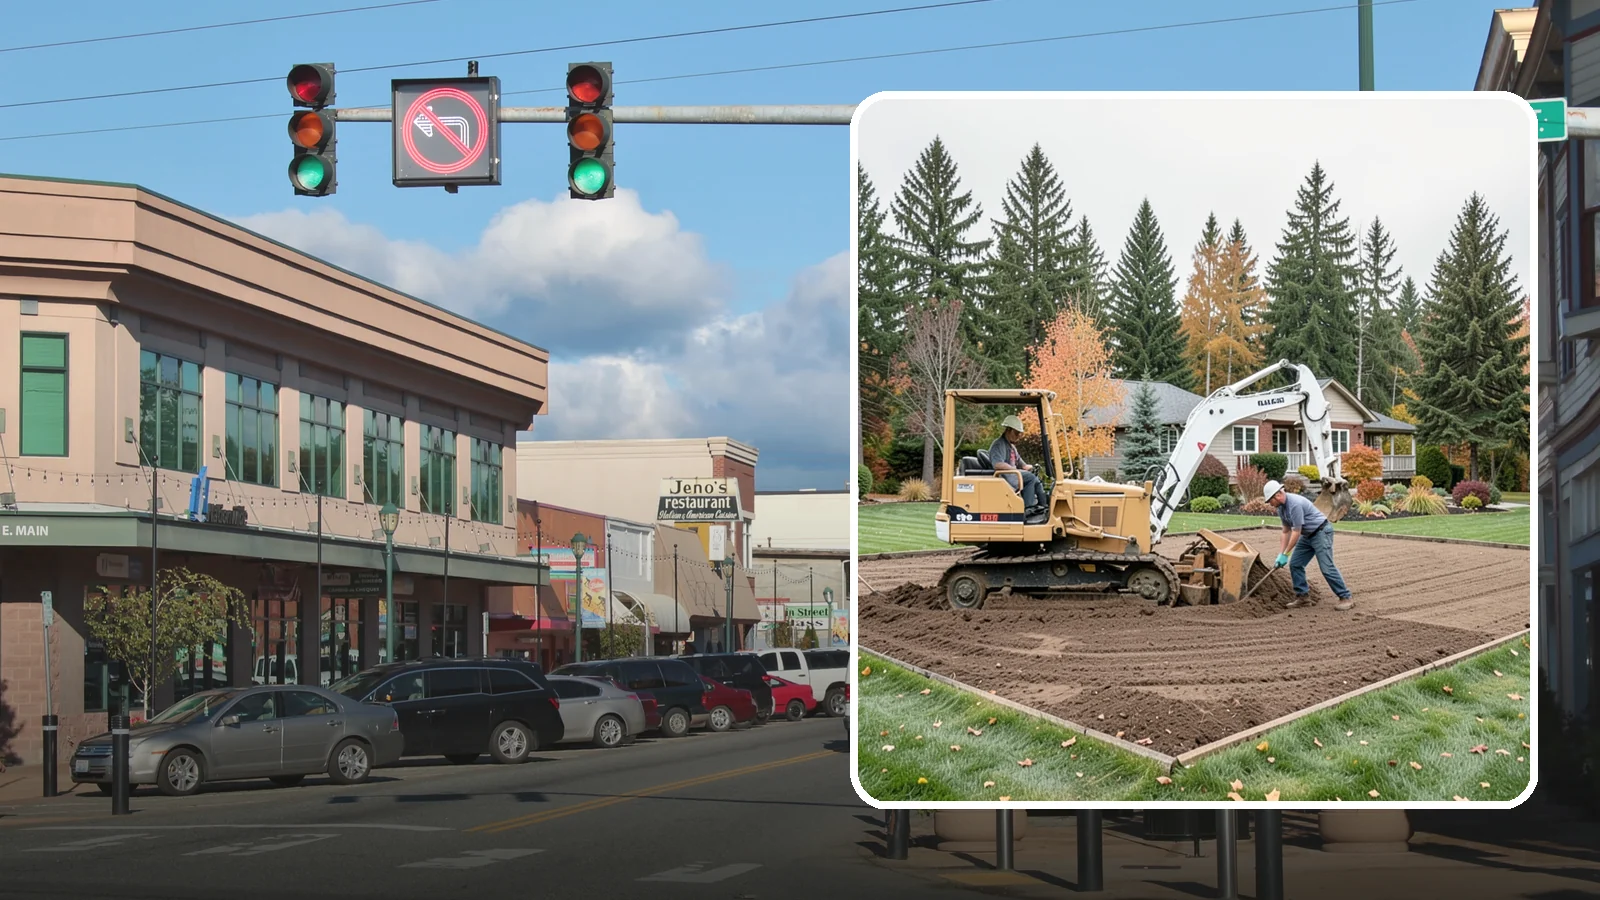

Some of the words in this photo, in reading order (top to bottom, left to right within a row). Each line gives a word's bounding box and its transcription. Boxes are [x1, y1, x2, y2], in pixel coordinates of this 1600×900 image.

[669, 480, 727, 494] Jeno's
[665, 496, 731, 509] restaurant
[686, 509, 715, 519] American
[715, 509, 738, 519] Cuisine
[2, 525, 13, 536] E.
[15, 525, 49, 536] MAIN
[797, 607, 828, 617] Street
